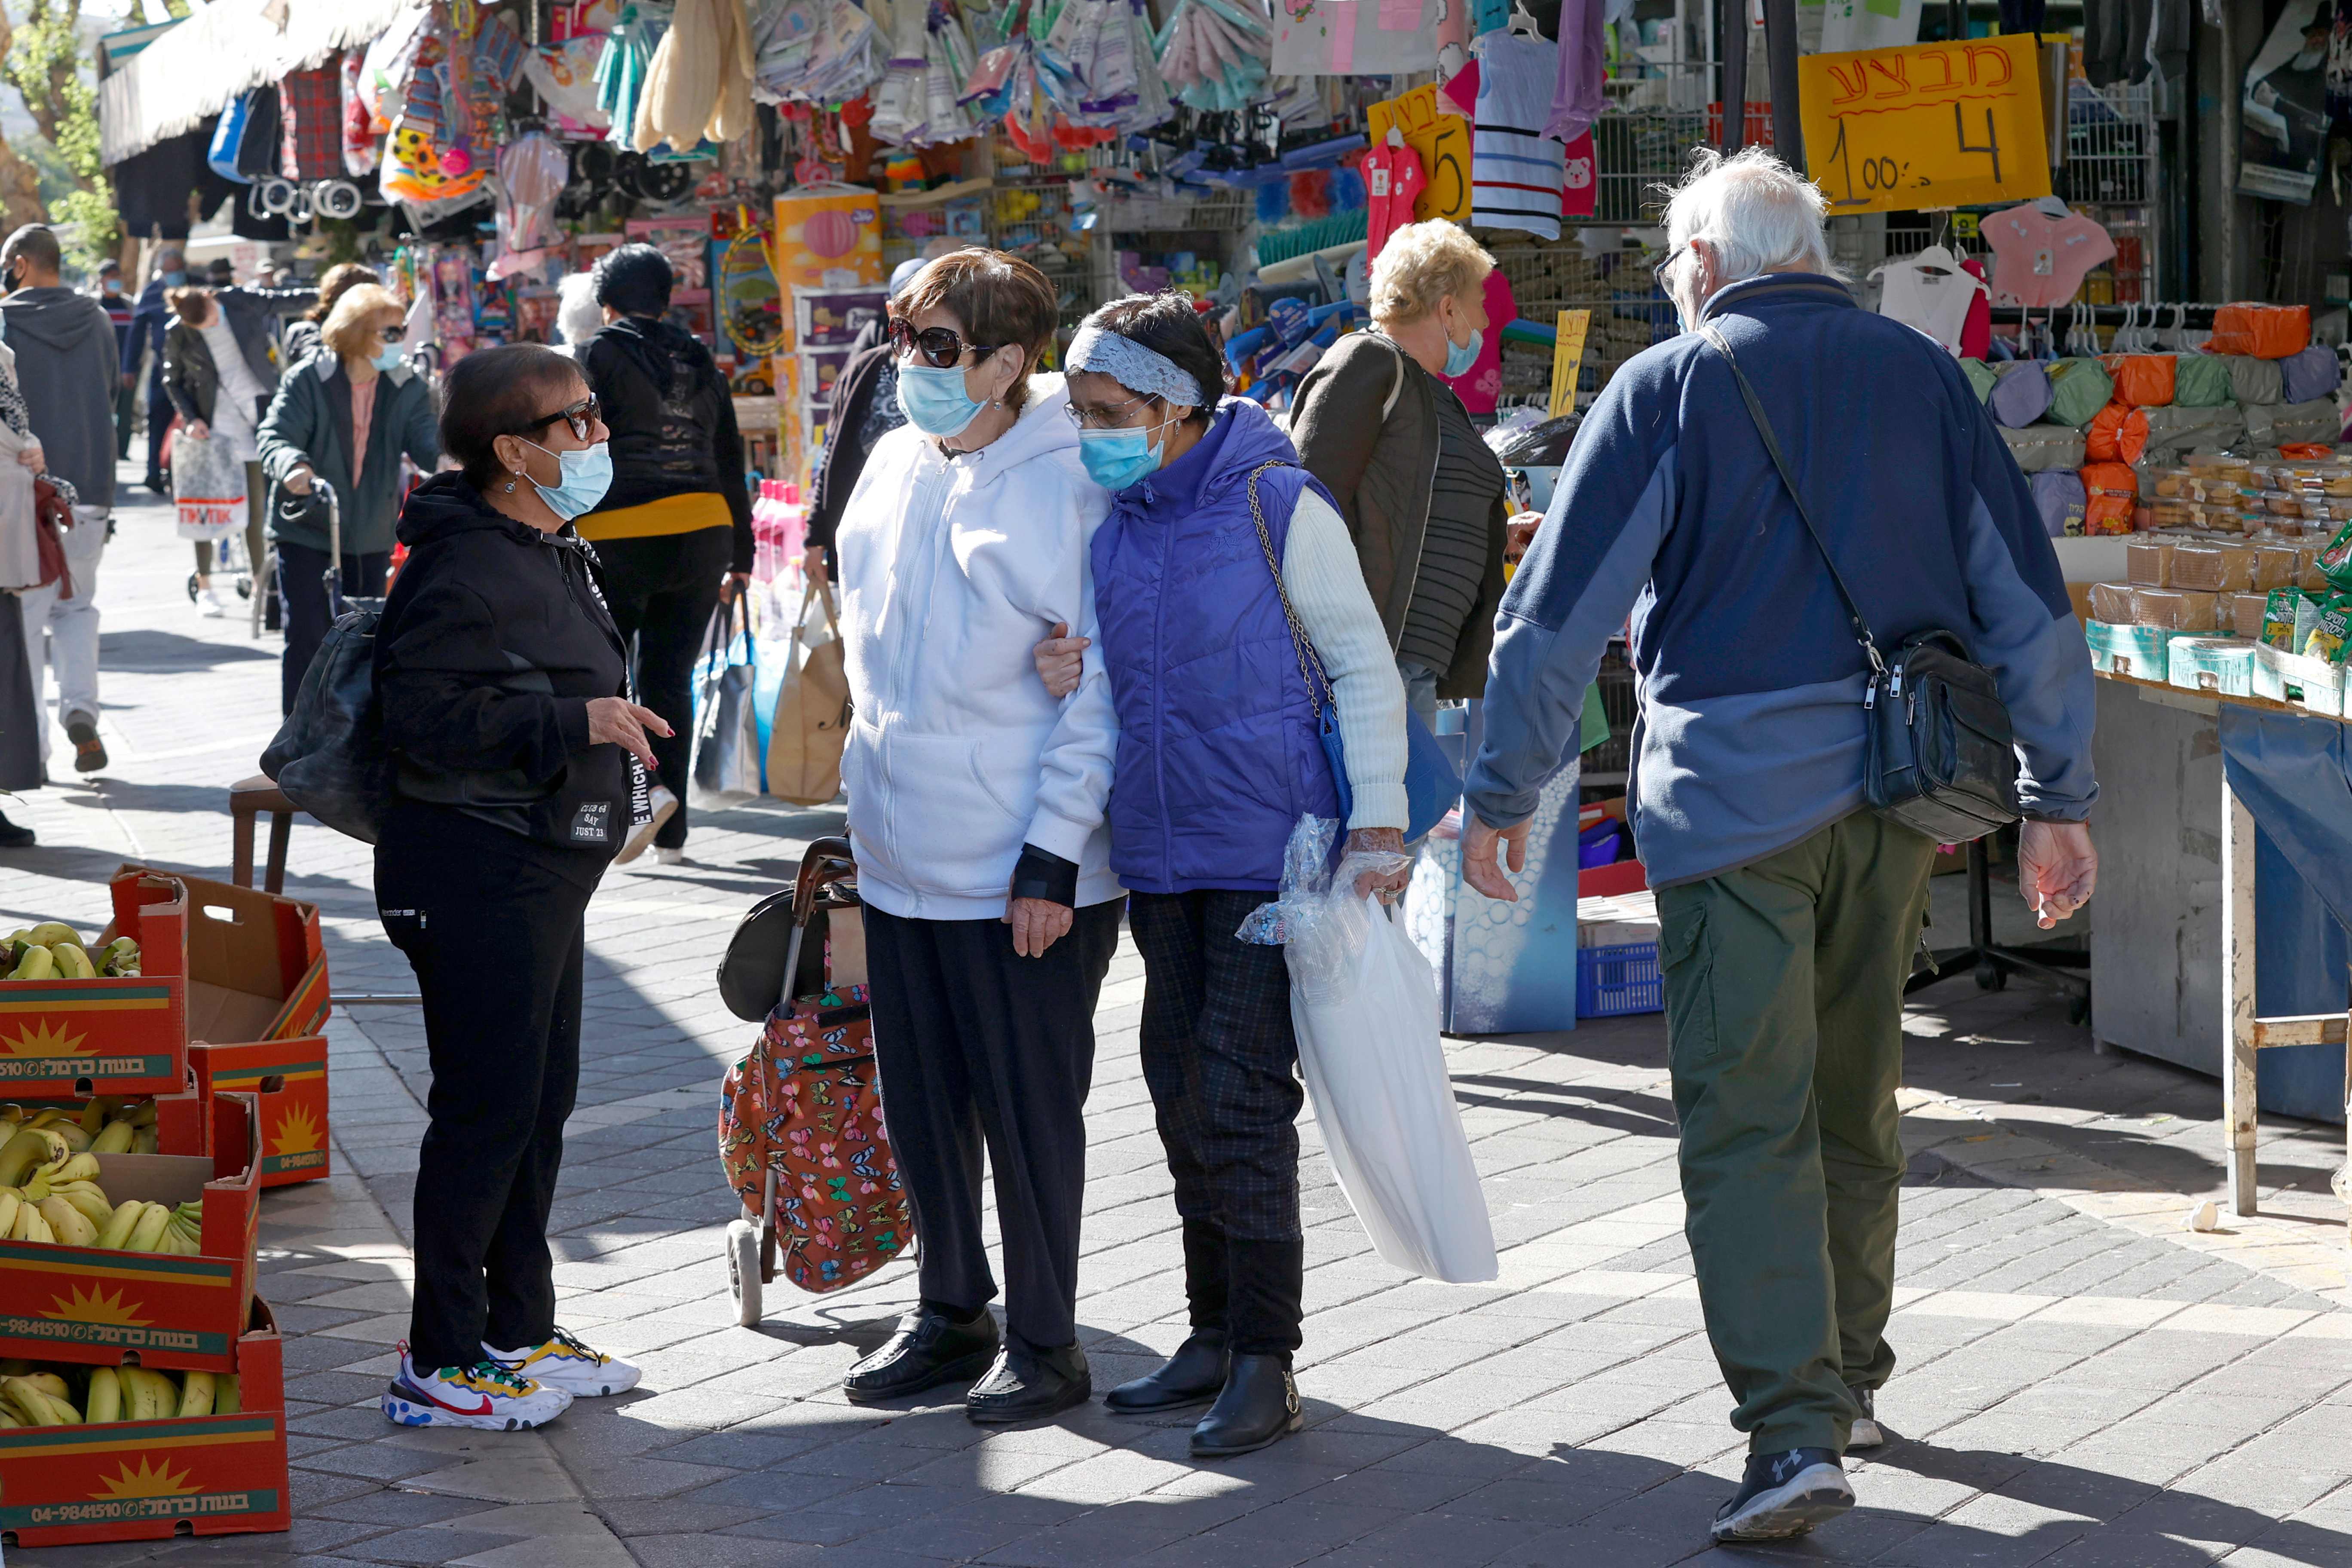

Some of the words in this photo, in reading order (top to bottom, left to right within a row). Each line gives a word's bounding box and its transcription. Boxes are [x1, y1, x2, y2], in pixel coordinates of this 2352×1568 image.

[1827, 46, 2012, 104] מבצע
[1954, 102, 2001, 183] 4
[632, 761, 649, 813] WHICH
[584, 813, 599, 826] SAY
[575, 826, 594, 836] JUST
[596, 828, 603, 837] 23
[98, 1058, 145, 1074] בננות
[149, 1330, 199, 1349] בננות
[31, 1503, 121, 1522] 04-9841510
[199, 1494, 249, 1512] בננות
